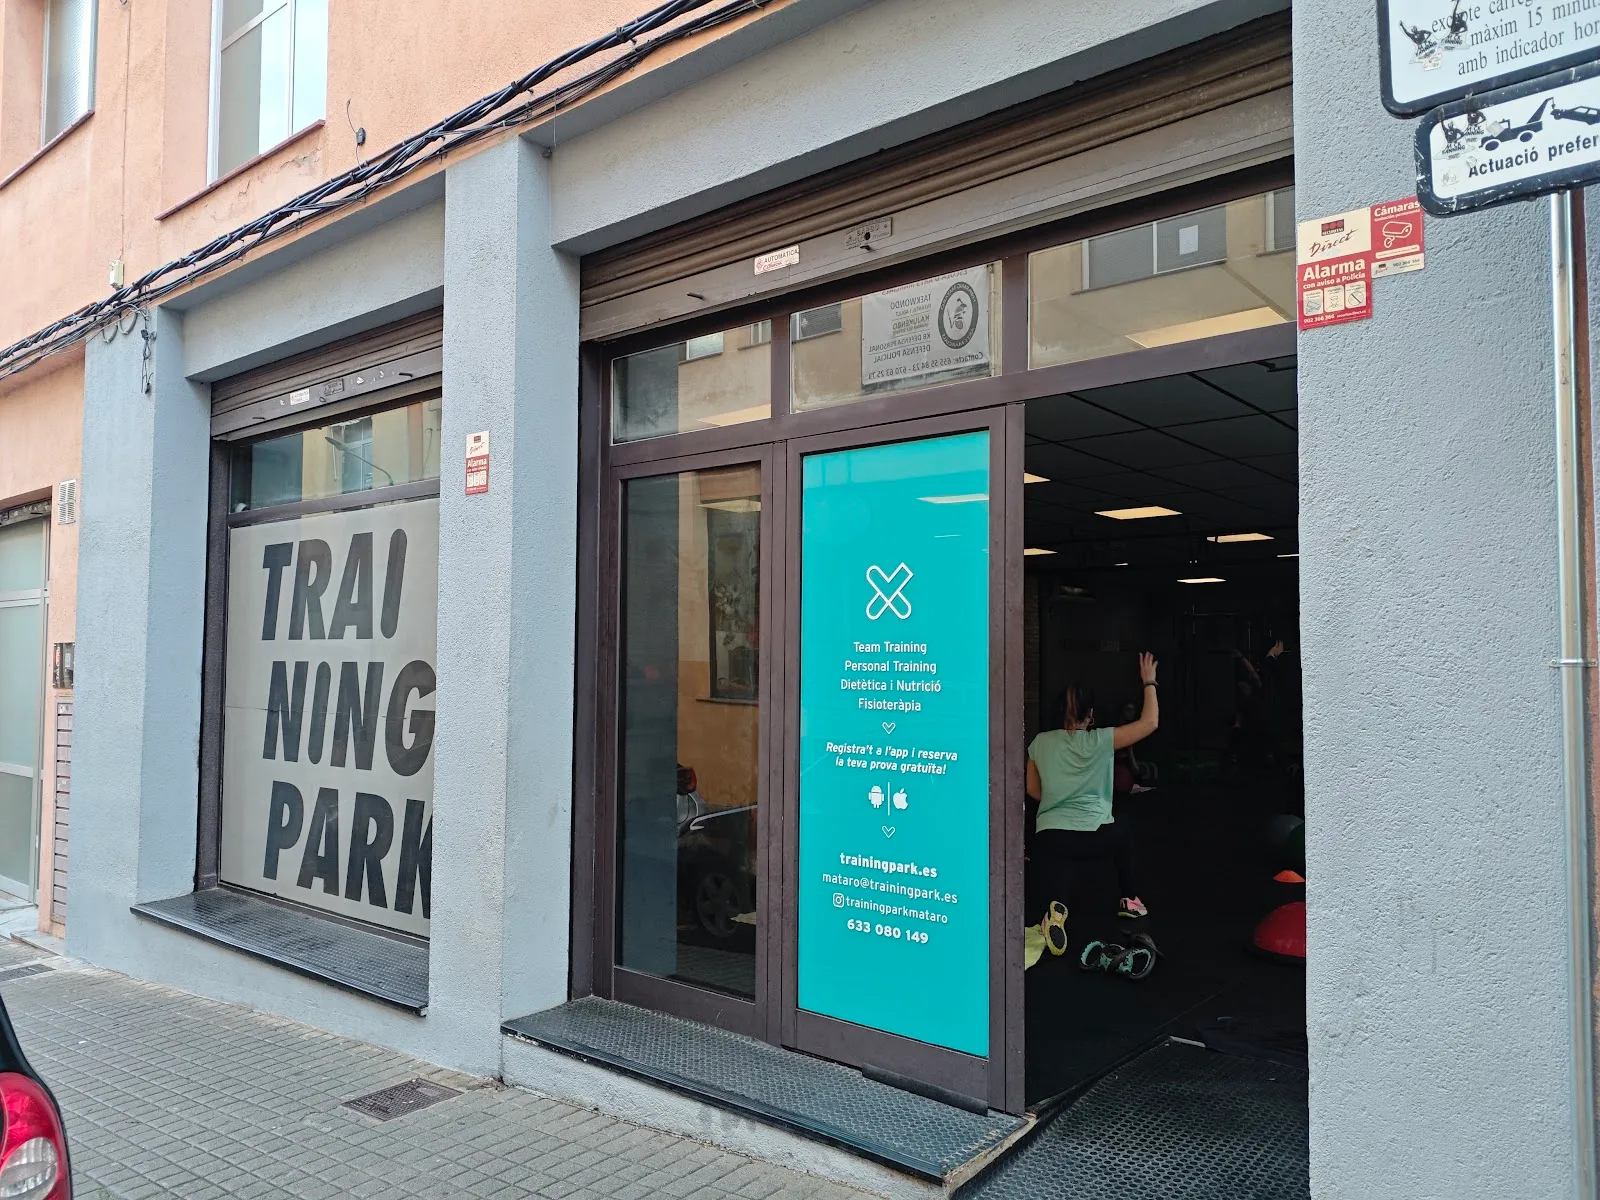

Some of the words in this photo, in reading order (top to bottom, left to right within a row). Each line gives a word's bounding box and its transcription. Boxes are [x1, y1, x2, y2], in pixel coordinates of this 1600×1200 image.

[1431, 5, 1481, 33] excpte
[1470, 19, 1518, 46] màxim
[1527, 6, 1543, 28] 15
[1458, 52, 1488, 75] amb
[1495, 30, 1565, 64] indicador
[1573, 20, 1600, 41] hor
[1468, 146, 1539, 178] Actuació
[1548, 134, 1600, 161] prefer
[1374, 200, 1420, 217] Cámaras
[1303, 258, 1366, 282] Alarma
[1317, 279, 1335, 287] aviso
[1342, 272, 1366, 282] Policía
[261, 528, 408, 641] TRAI
[853, 641, 881, 653] Team
[884, 641, 927, 655] Training
[844, 660, 890, 672] Personal
[893, 661, 937, 675] Training
[840, 679, 887, 690] Dietètica
[890, 680, 894, 691] i
[896, 679, 941, 692] Nutrició
[858, 698, 921, 713] Fisioteràpia
[262, 660, 437, 777] NING
[826, 742, 874, 756] Registra't
[876, 748, 882, 756] a
[885, 746, 909, 759] l'app
[917, 749, 958, 761] reserva
[835, 756, 844, 767] la
[847, 757, 867, 768] teva
[870, 760, 898, 771] prova
[900, 762, 947, 775] gratuïta!
[840, 852, 938, 878] trainingpark.es
[822, 873, 958, 904] mataro@trainingpark.es
[845, 896, 948, 924] trainingparkmataro
[847, 919, 871, 933] 633
[875, 924, 901, 939] 080
[905, 929, 929, 944] 149
